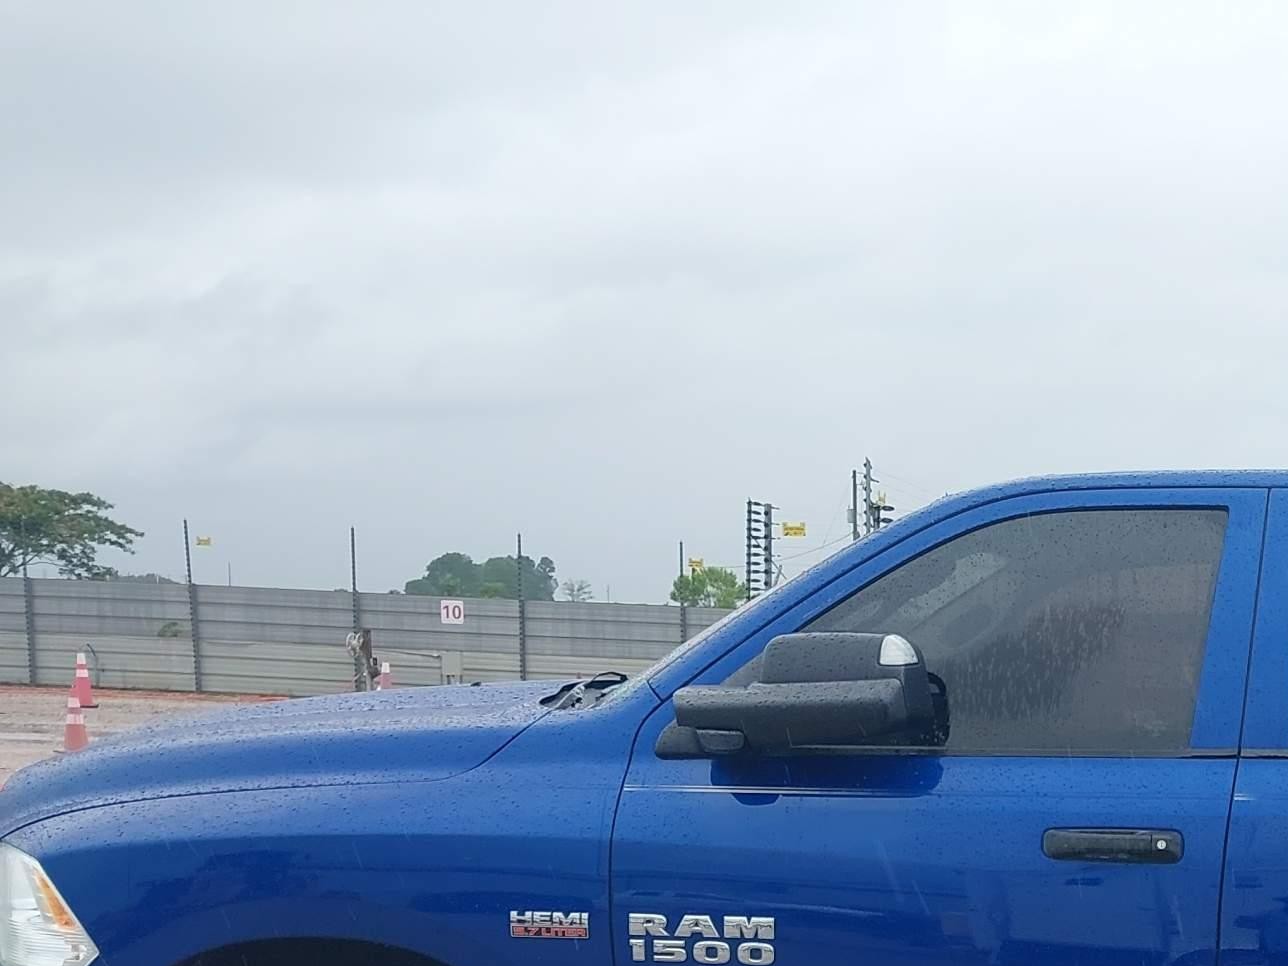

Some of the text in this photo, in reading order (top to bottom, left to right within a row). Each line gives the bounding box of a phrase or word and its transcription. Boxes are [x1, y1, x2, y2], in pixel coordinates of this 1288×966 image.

[442, 604, 462, 620] 10
[510, 911, 589, 927] HEMI
[628, 912, 776, 940] RAM
[629, 938, 776, 966] 1500
